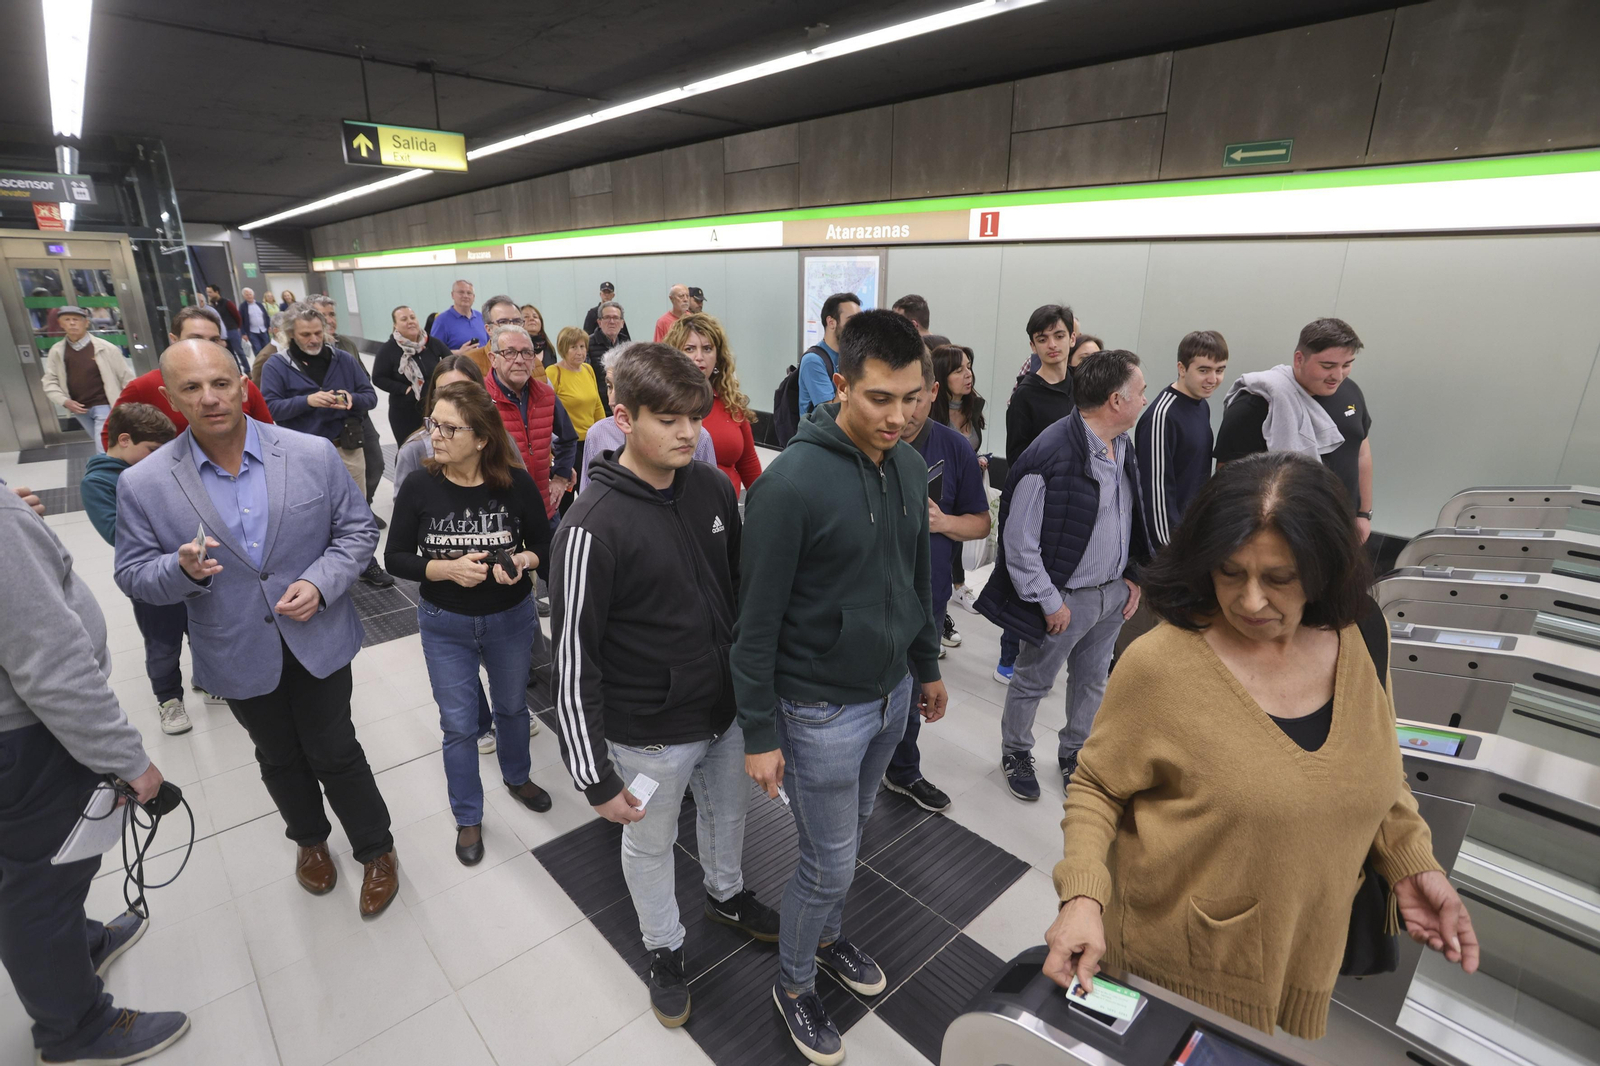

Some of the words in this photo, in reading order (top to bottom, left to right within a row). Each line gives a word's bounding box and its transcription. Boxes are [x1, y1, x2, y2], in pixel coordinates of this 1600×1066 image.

[392, 134, 437, 153] Salida
[393, 151, 411, 163] Exit
[825, 223, 910, 241] Atarazanas
[983, 212, 995, 236] 1
